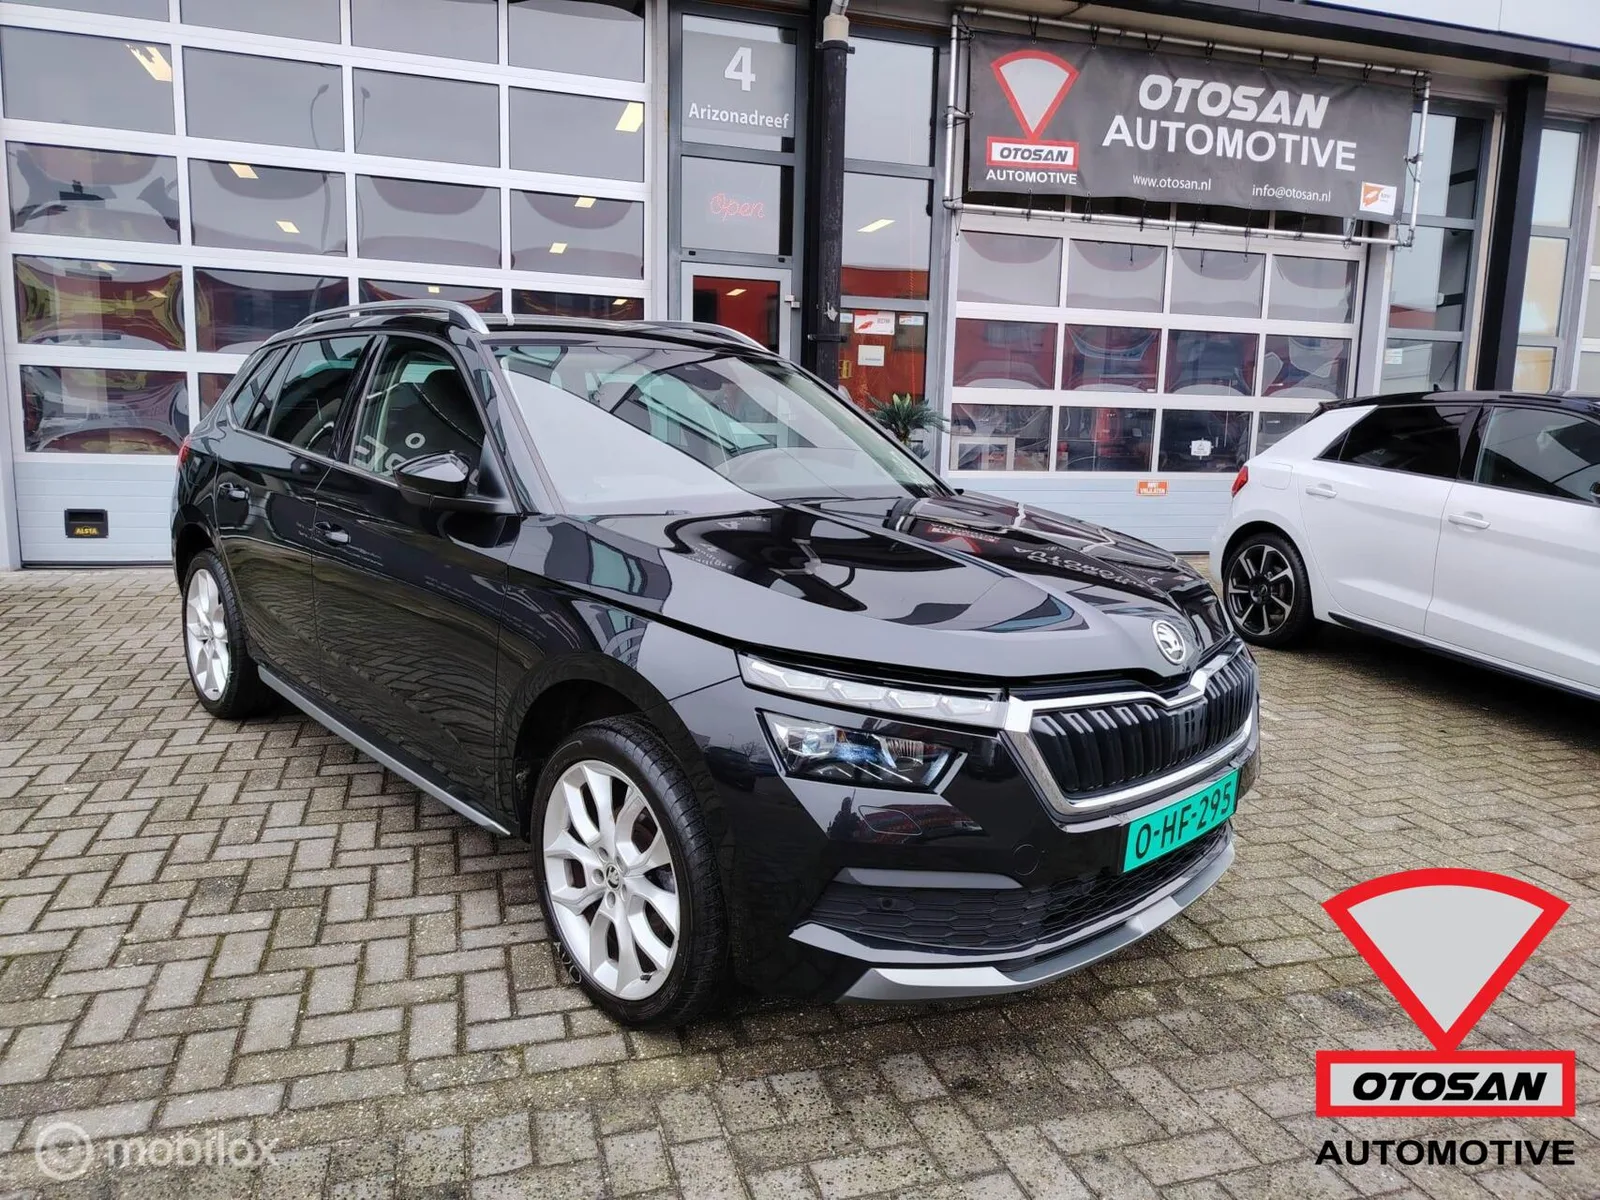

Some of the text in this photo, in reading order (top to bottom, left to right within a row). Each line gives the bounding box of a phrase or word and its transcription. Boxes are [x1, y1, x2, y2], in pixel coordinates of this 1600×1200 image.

[725, 46, 756, 92] 4
[1139, 74, 1330, 129] OTOSAN
[688, 102, 790, 129] Arizonadreef
[1000, 147, 1068, 162] OTOSAN
[1102, 115, 1357, 171] AUTOMOTIVE
[986, 169, 1078, 185] AUTOMOTIVE
[1133, 174, 1211, 191] www.otosan.nl
[1252, 184, 1331, 203] info@otosan.nl
[710, 193, 765, 222] Open
[75, 527, 98, 535] ALSTA
